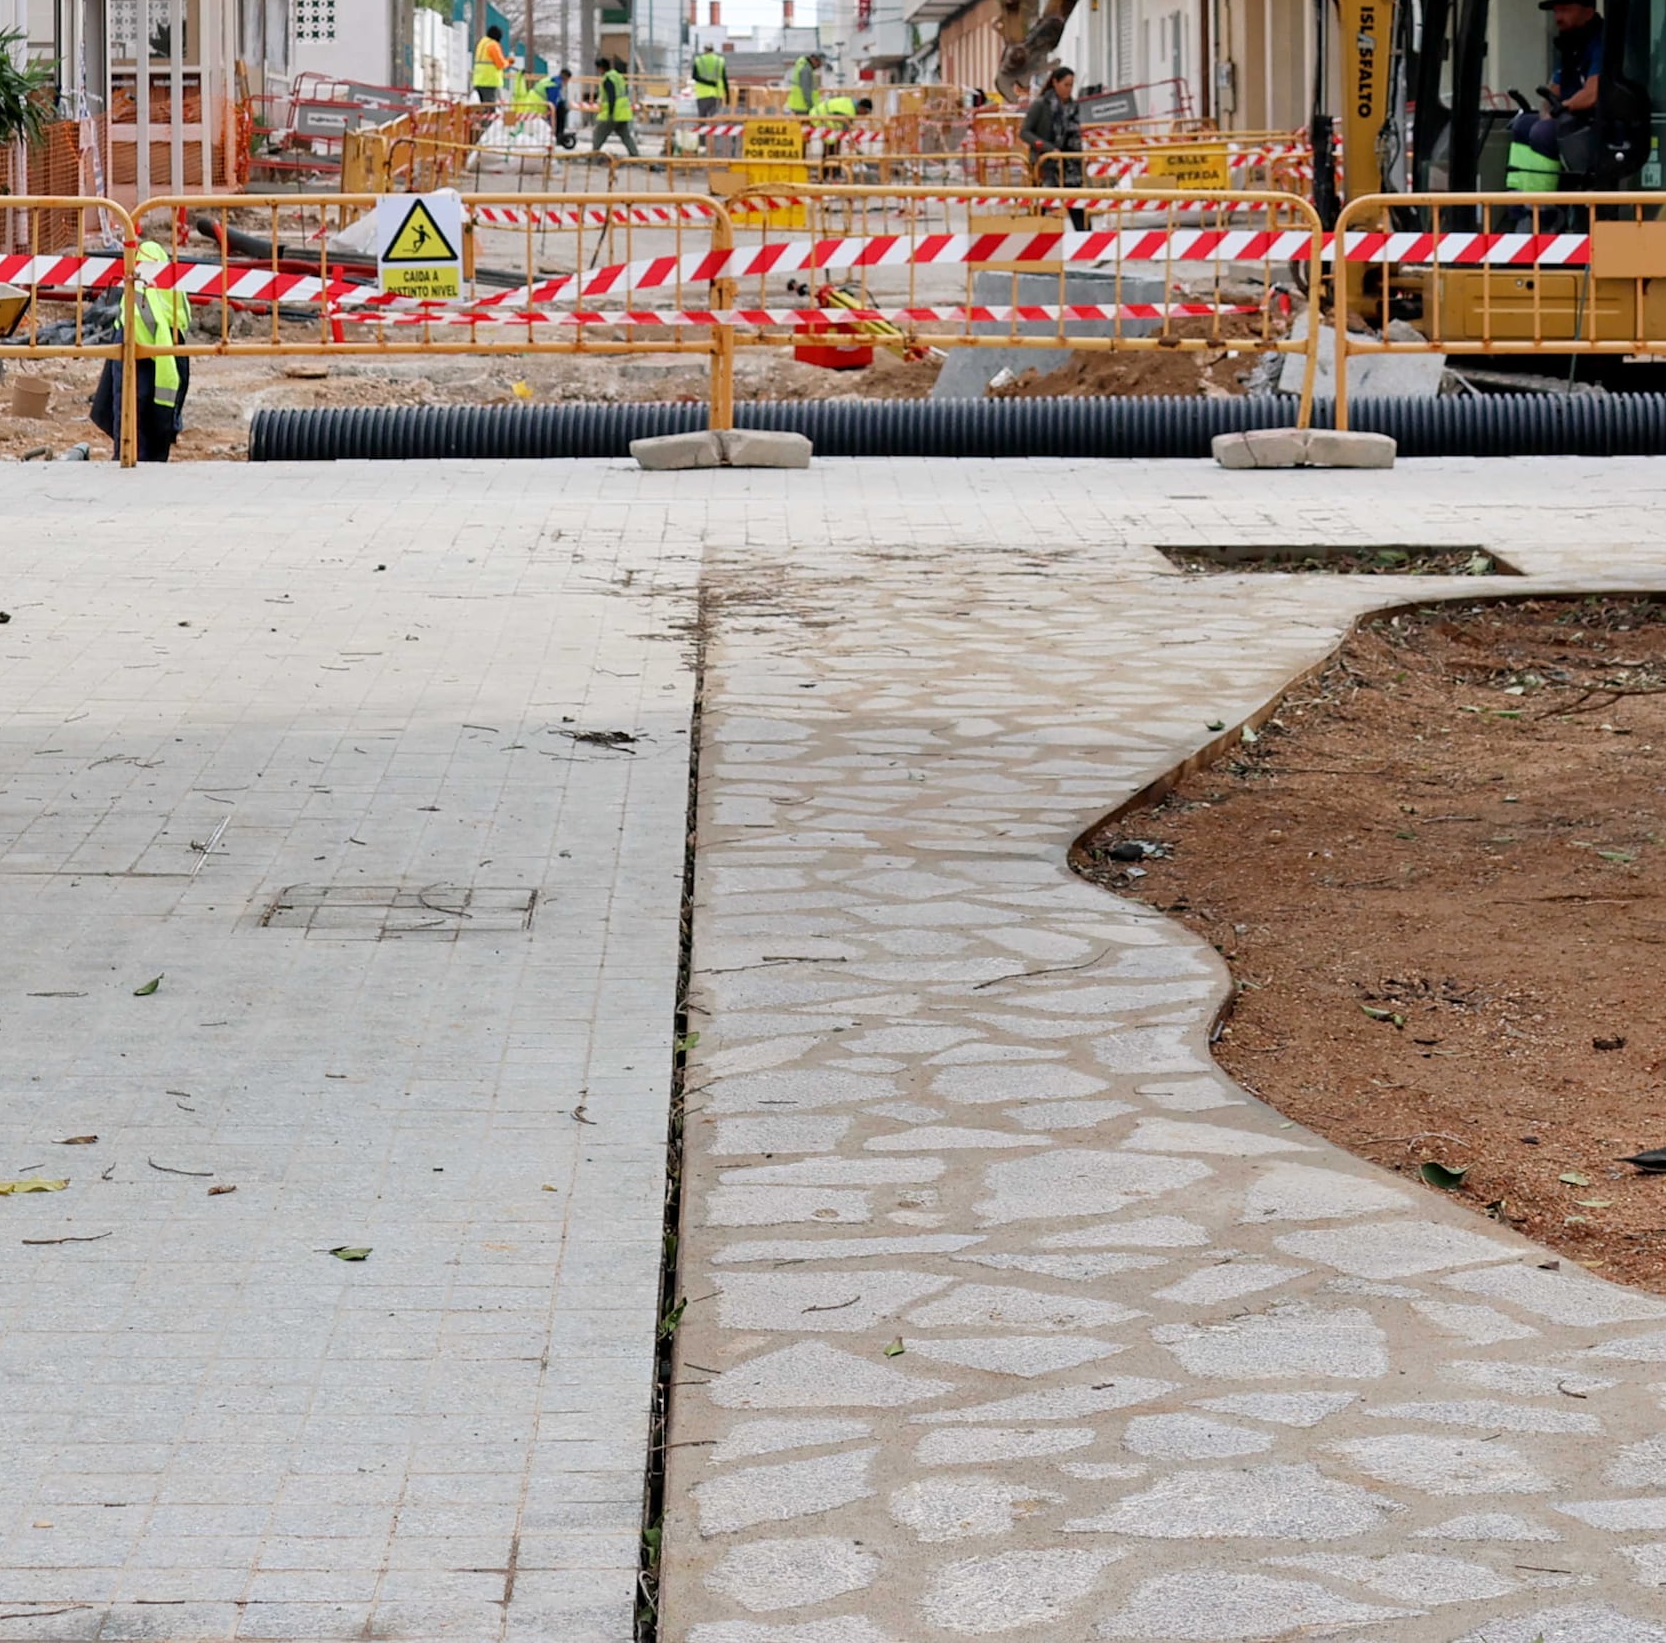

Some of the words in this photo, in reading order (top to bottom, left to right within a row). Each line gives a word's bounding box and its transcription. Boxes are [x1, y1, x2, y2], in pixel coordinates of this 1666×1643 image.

[1357, 6, 1376, 118] ISLASFALTO
[757, 126, 787, 135] CALLE
[749, 137, 794, 146] CORTADA
[745, 150, 764, 158] POR
[767, 150, 799, 159] OBRAS
[403, 270, 430, 282] CAIDA
[432, 269, 439, 281] A
[431, 285, 458, 296] NIVEL
